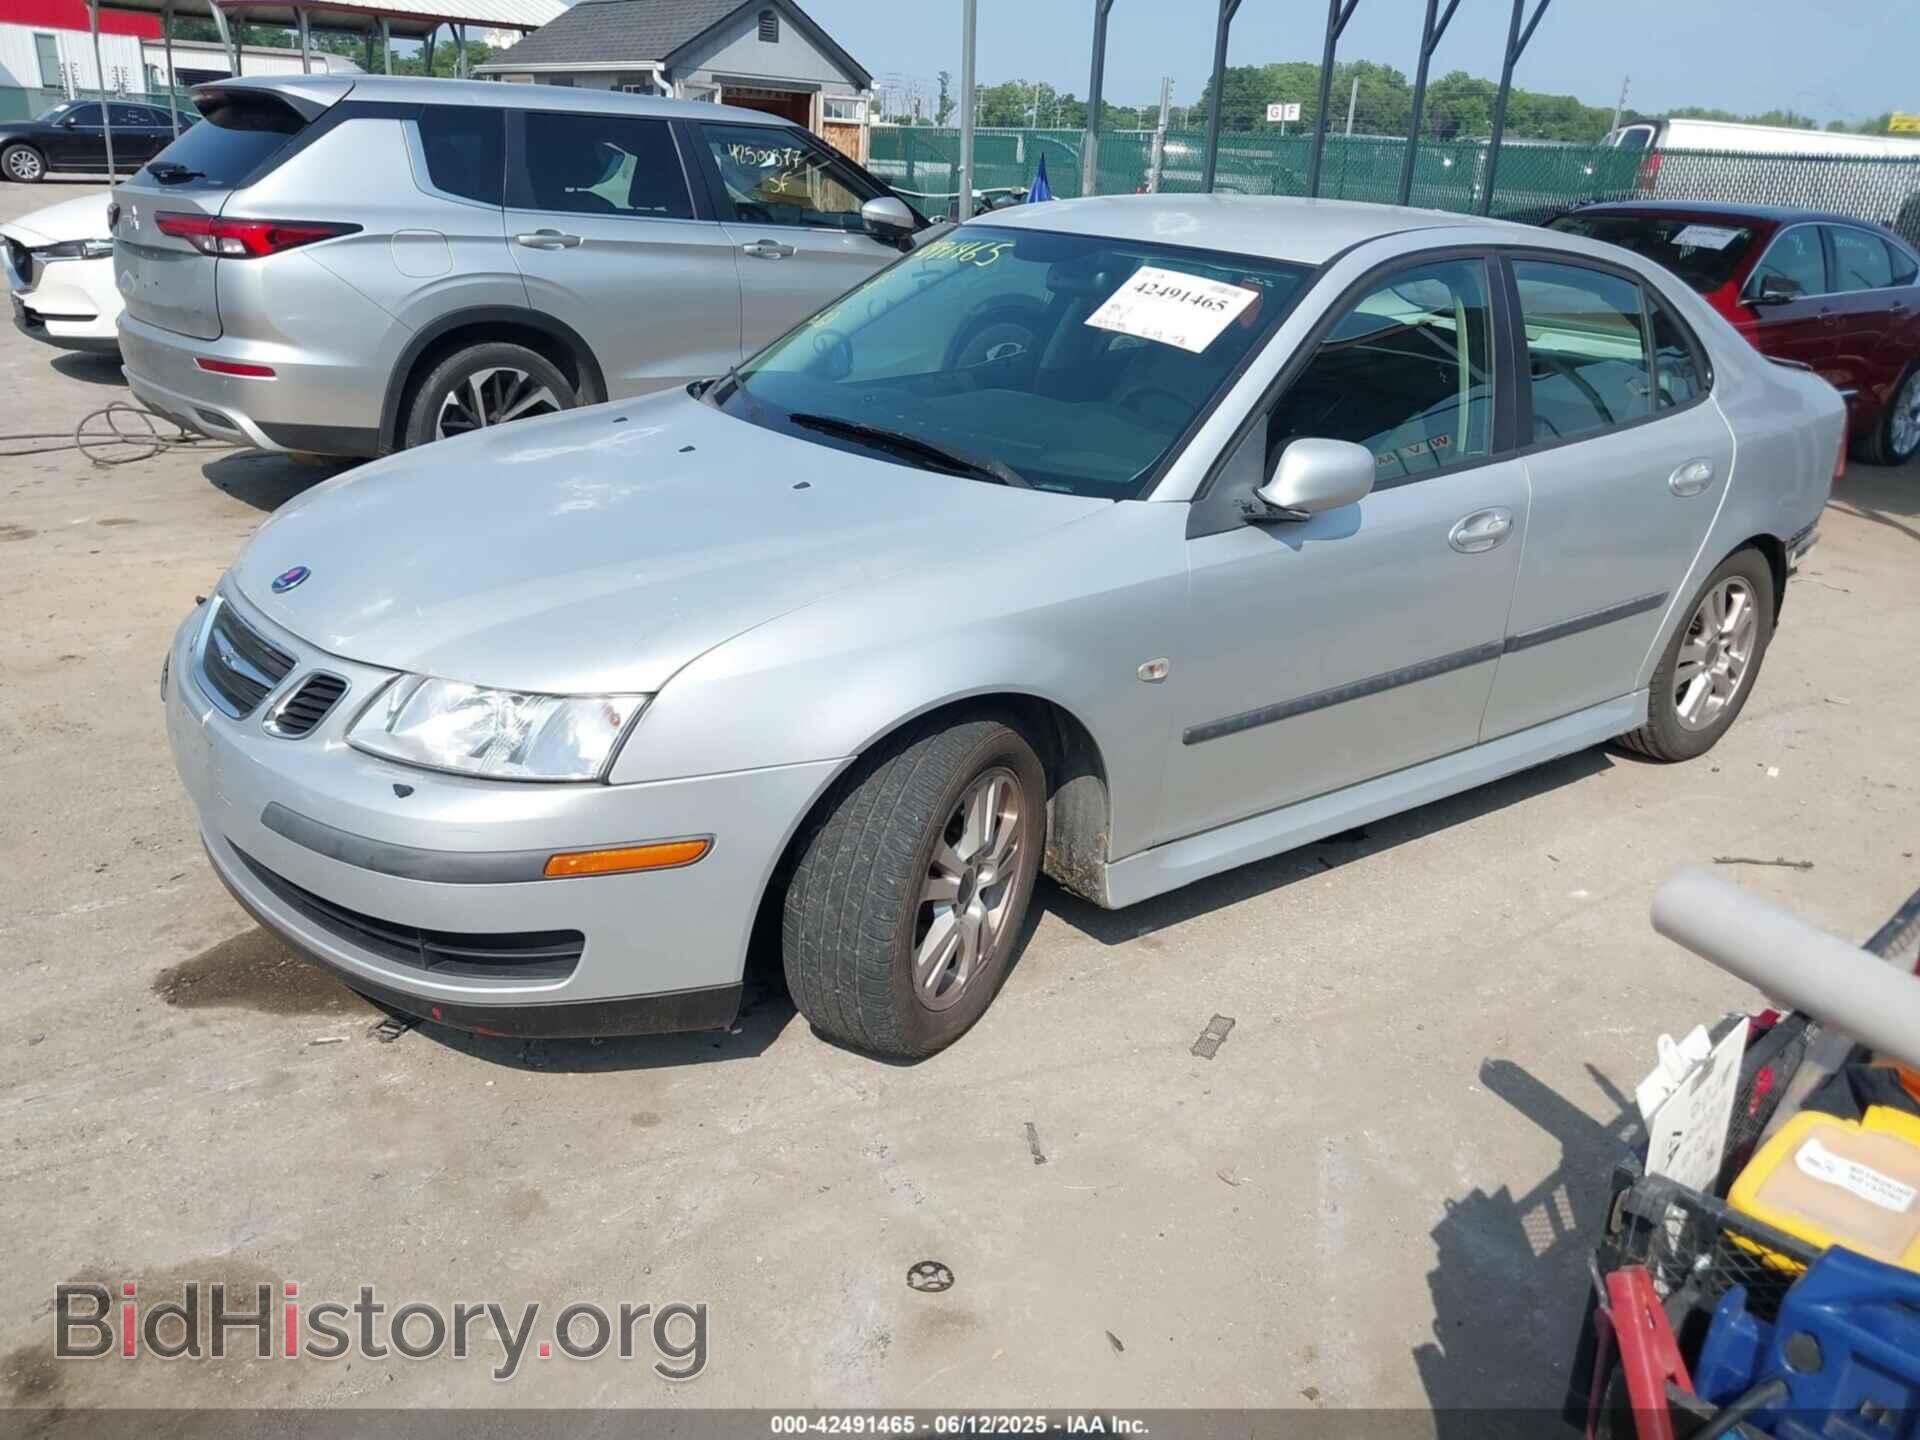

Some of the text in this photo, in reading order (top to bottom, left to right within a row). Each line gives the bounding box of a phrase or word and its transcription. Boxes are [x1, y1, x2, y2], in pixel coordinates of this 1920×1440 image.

[1271, 106, 1296, 118] G F
[727, 143, 801, 169] 42500377
[1133, 281, 1230, 313] 42491465
